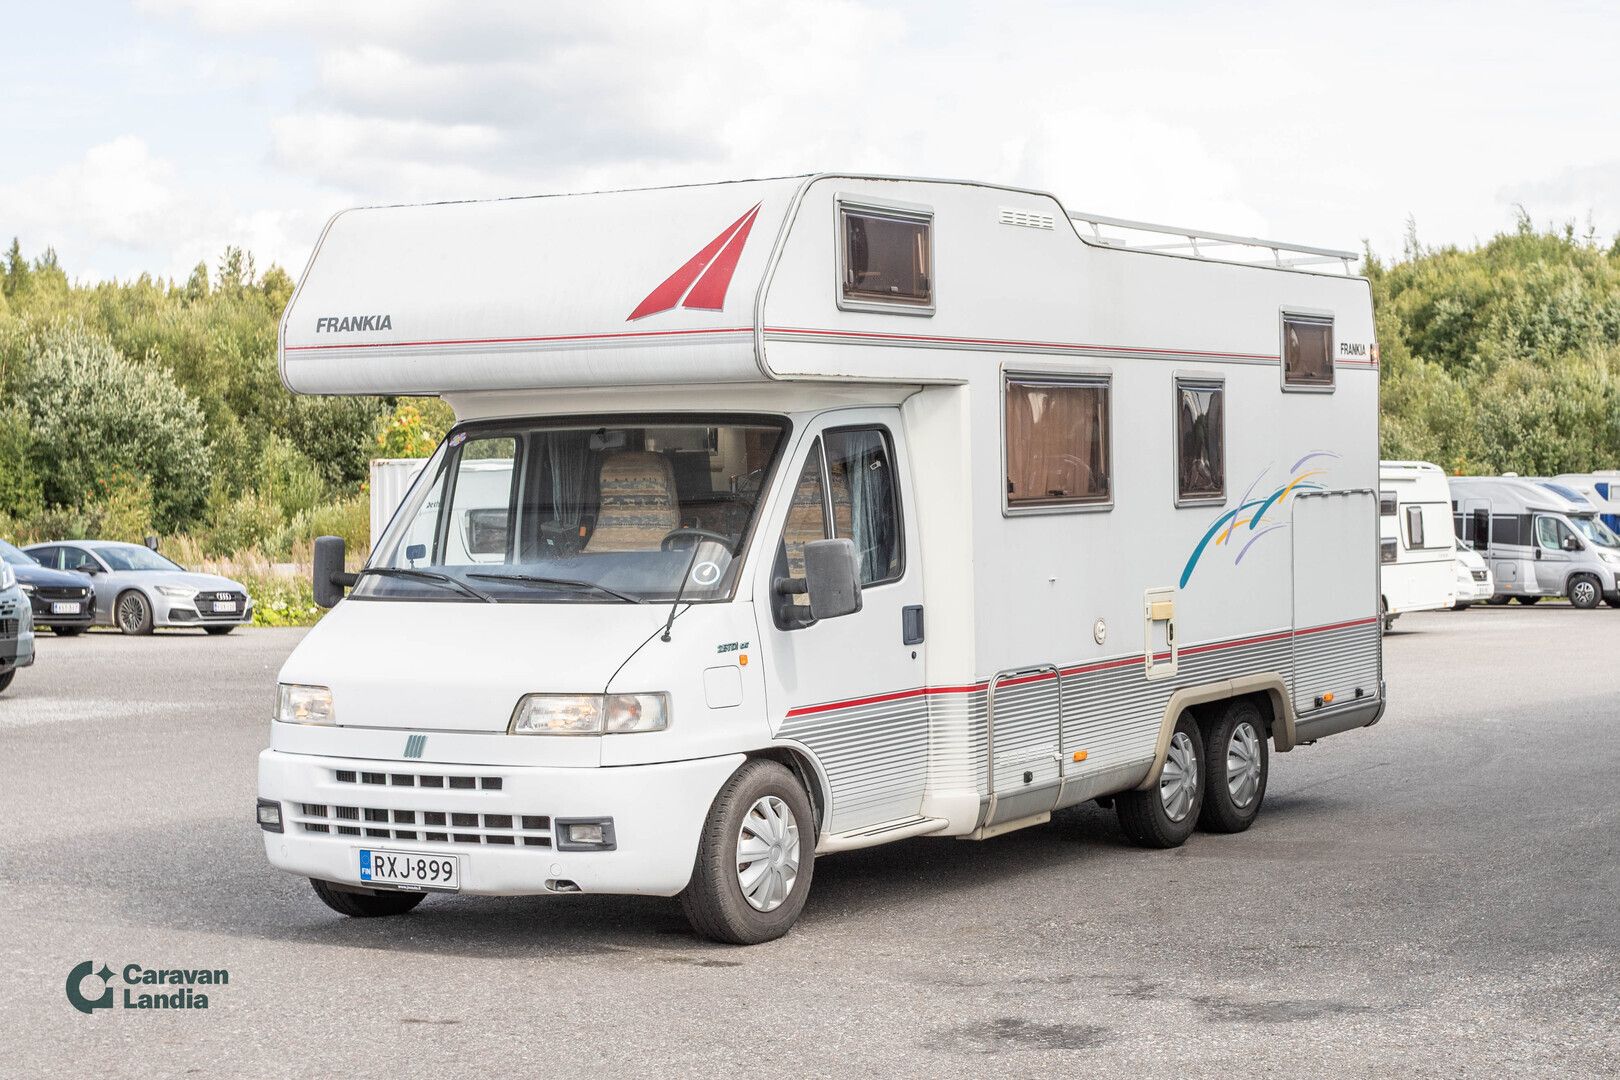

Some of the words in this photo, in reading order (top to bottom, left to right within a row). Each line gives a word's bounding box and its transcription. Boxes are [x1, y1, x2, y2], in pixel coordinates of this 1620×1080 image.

[316, 315, 392, 333] FRANKIA
[1340, 343, 1366, 355] FRANKIA
[374, 855, 453, 882] RXJ-899
